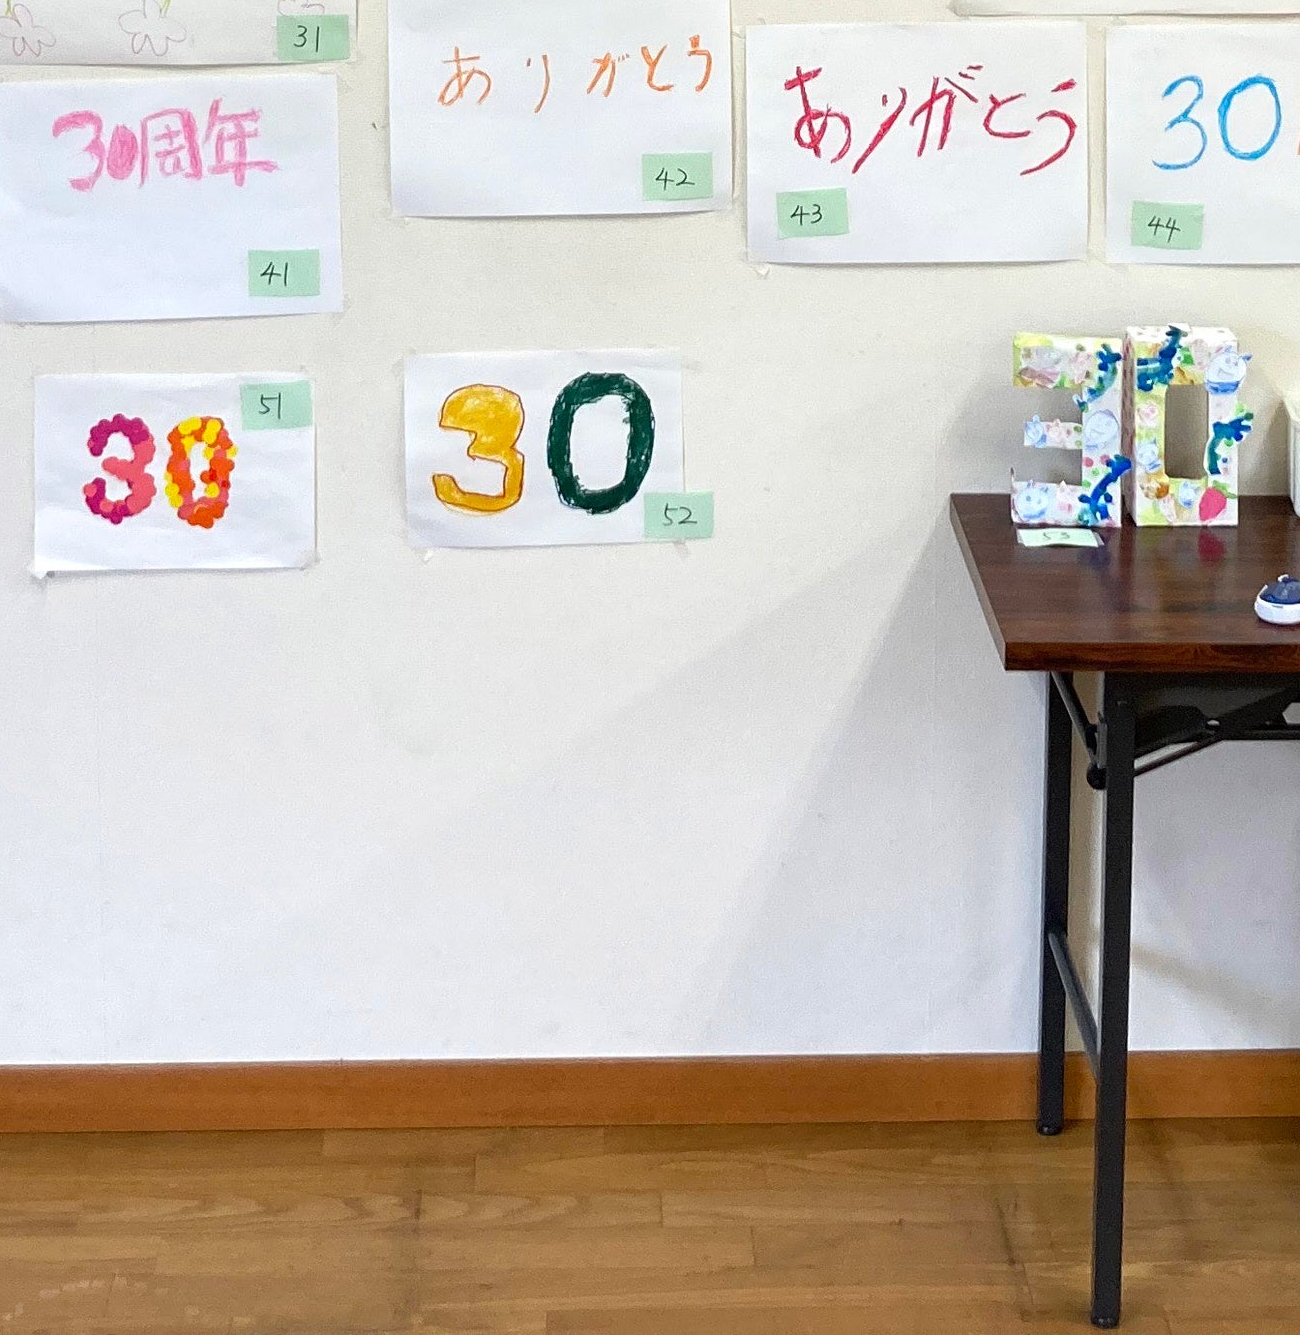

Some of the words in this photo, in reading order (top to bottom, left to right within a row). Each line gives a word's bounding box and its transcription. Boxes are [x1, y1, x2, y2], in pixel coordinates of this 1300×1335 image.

[293, 25, 323, 52] 31
[437, 34, 713, 113] ありがとう
[784, 65, 1078, 176] ありがとう
[52, 99, 279, 190] 30周年
[656, 167, 696, 189] 42
[790, 203, 824, 223] 43
[1149, 217, 1180, 239] 44
[260, 262, 289, 285] 41
[260, 392, 283, 419] 51
[432, 372, 654, 515] 30
[82, 413, 237, 530] 30
[662, 503, 699, 528] 52
